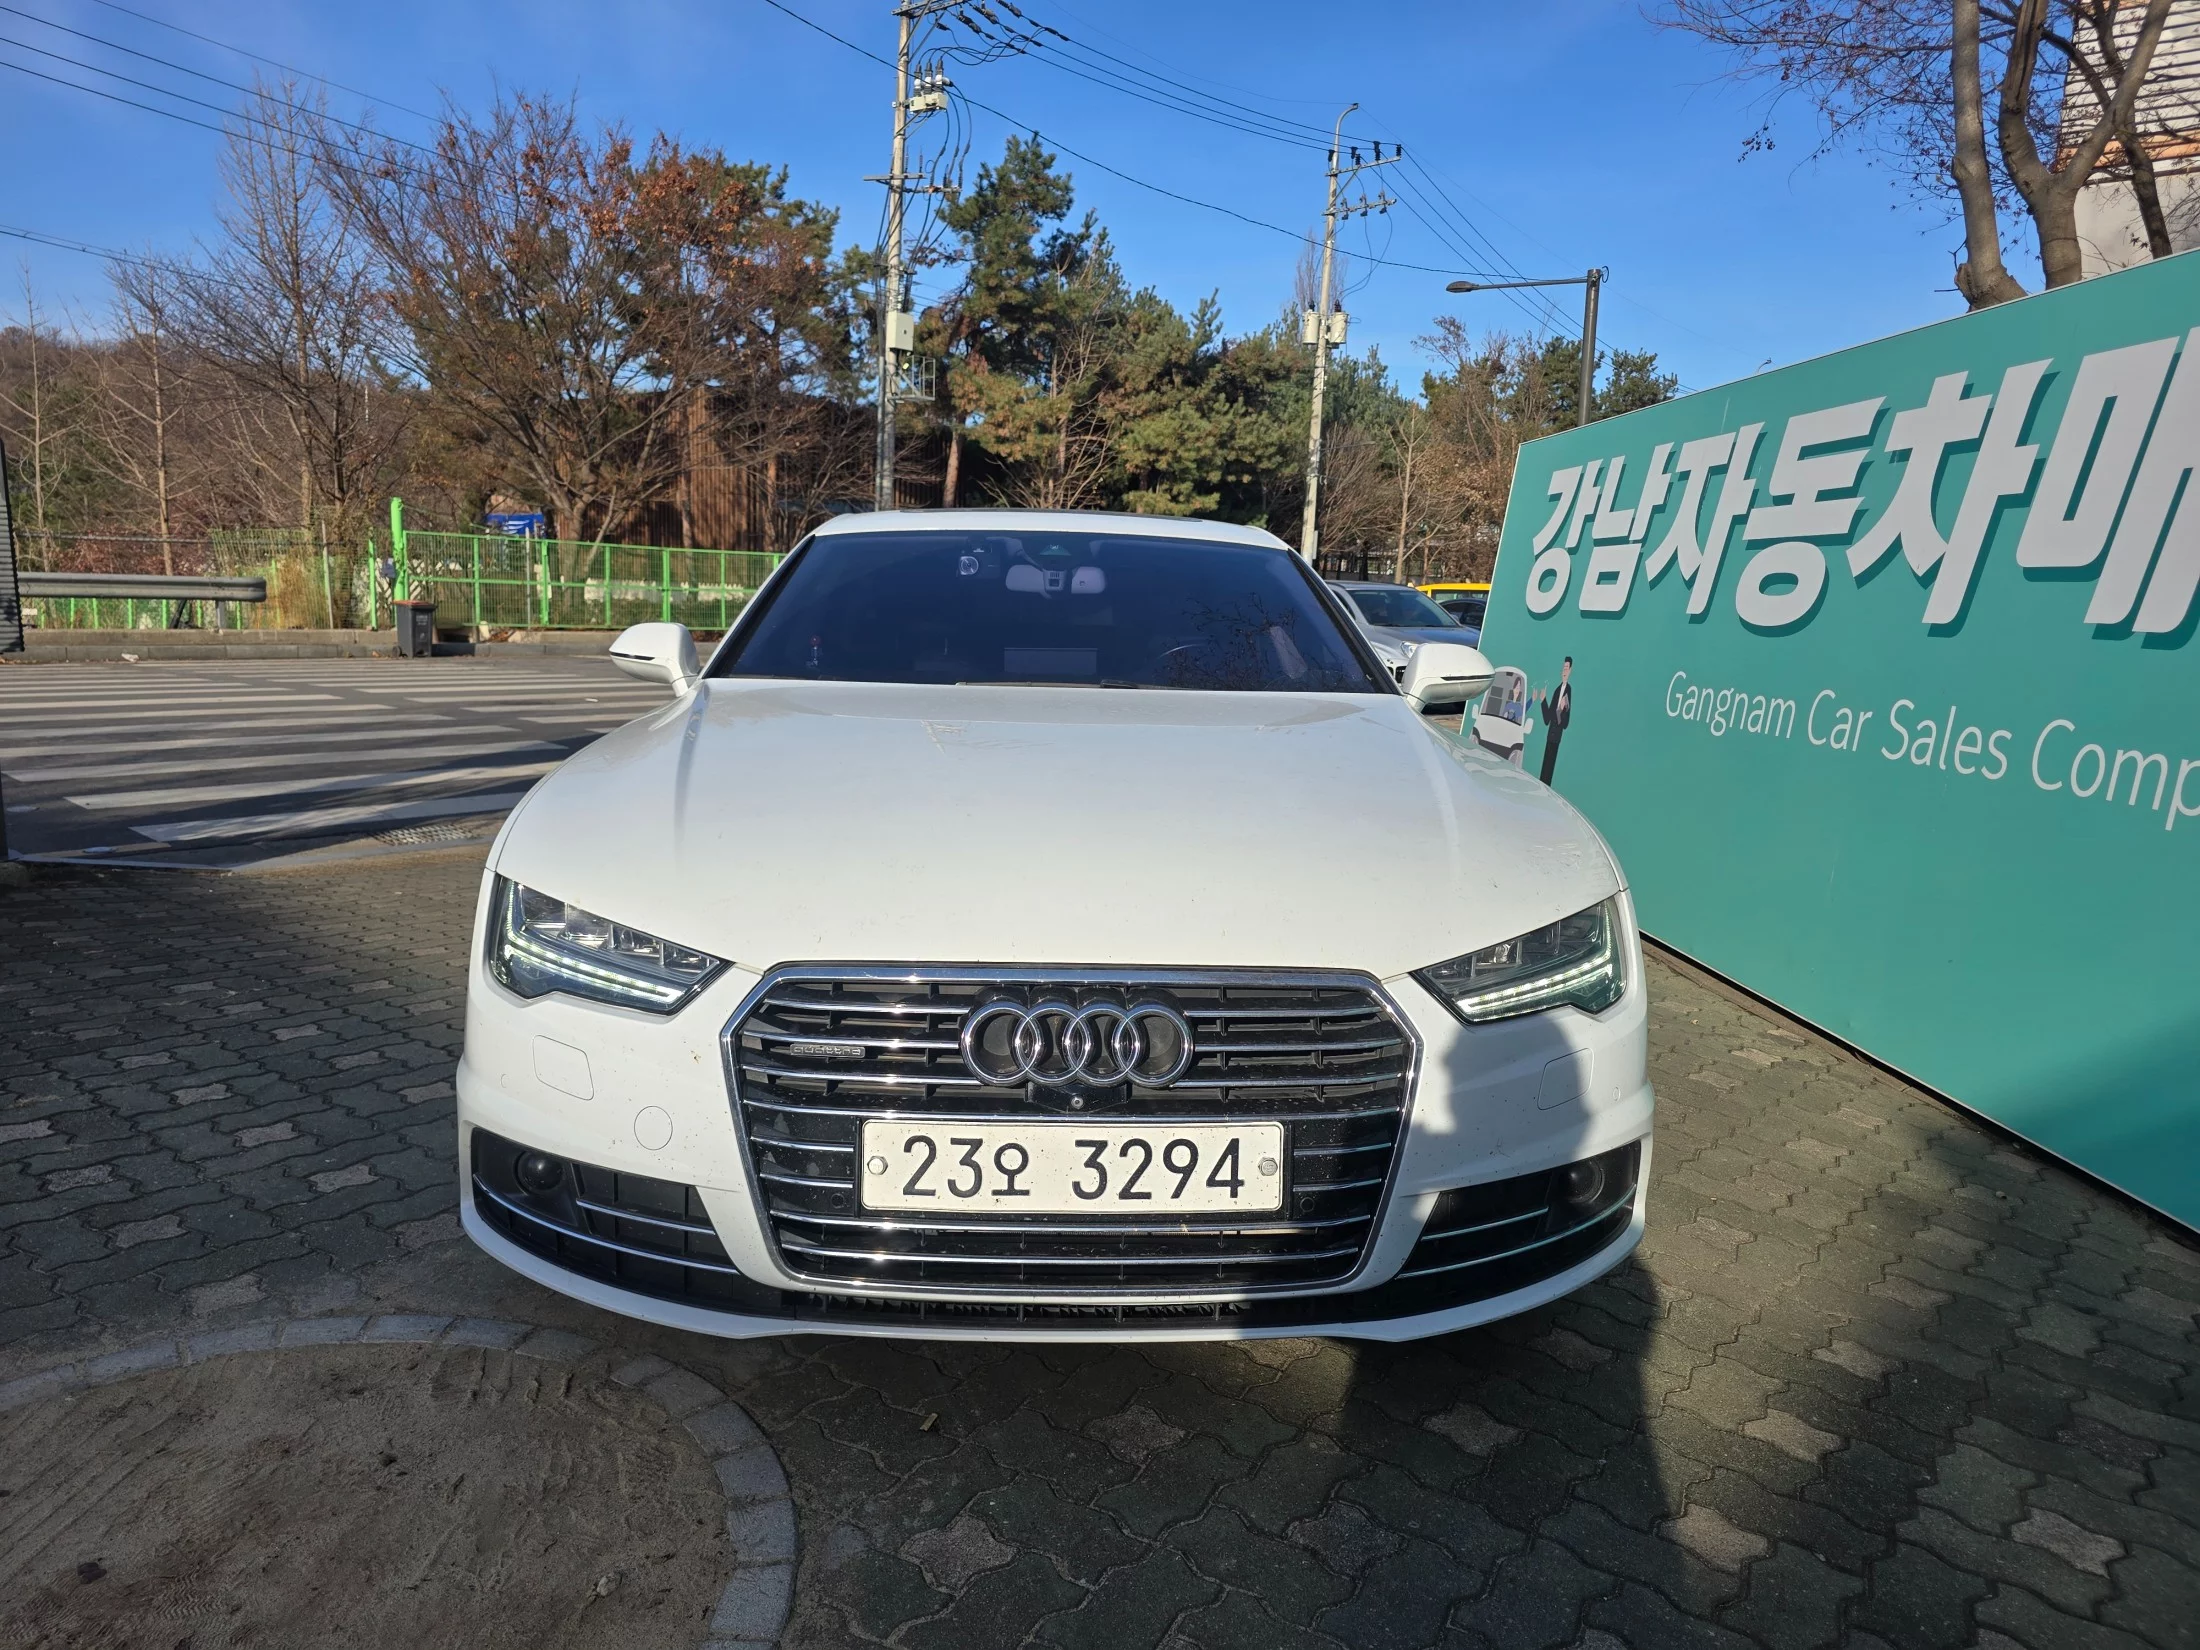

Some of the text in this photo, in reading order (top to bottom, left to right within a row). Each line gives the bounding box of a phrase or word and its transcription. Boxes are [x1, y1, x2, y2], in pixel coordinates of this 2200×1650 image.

[1666, 671, 2200, 832] Gangnam Car Sales Comp
[902, 1135, 1245, 1200] 23오 3294
